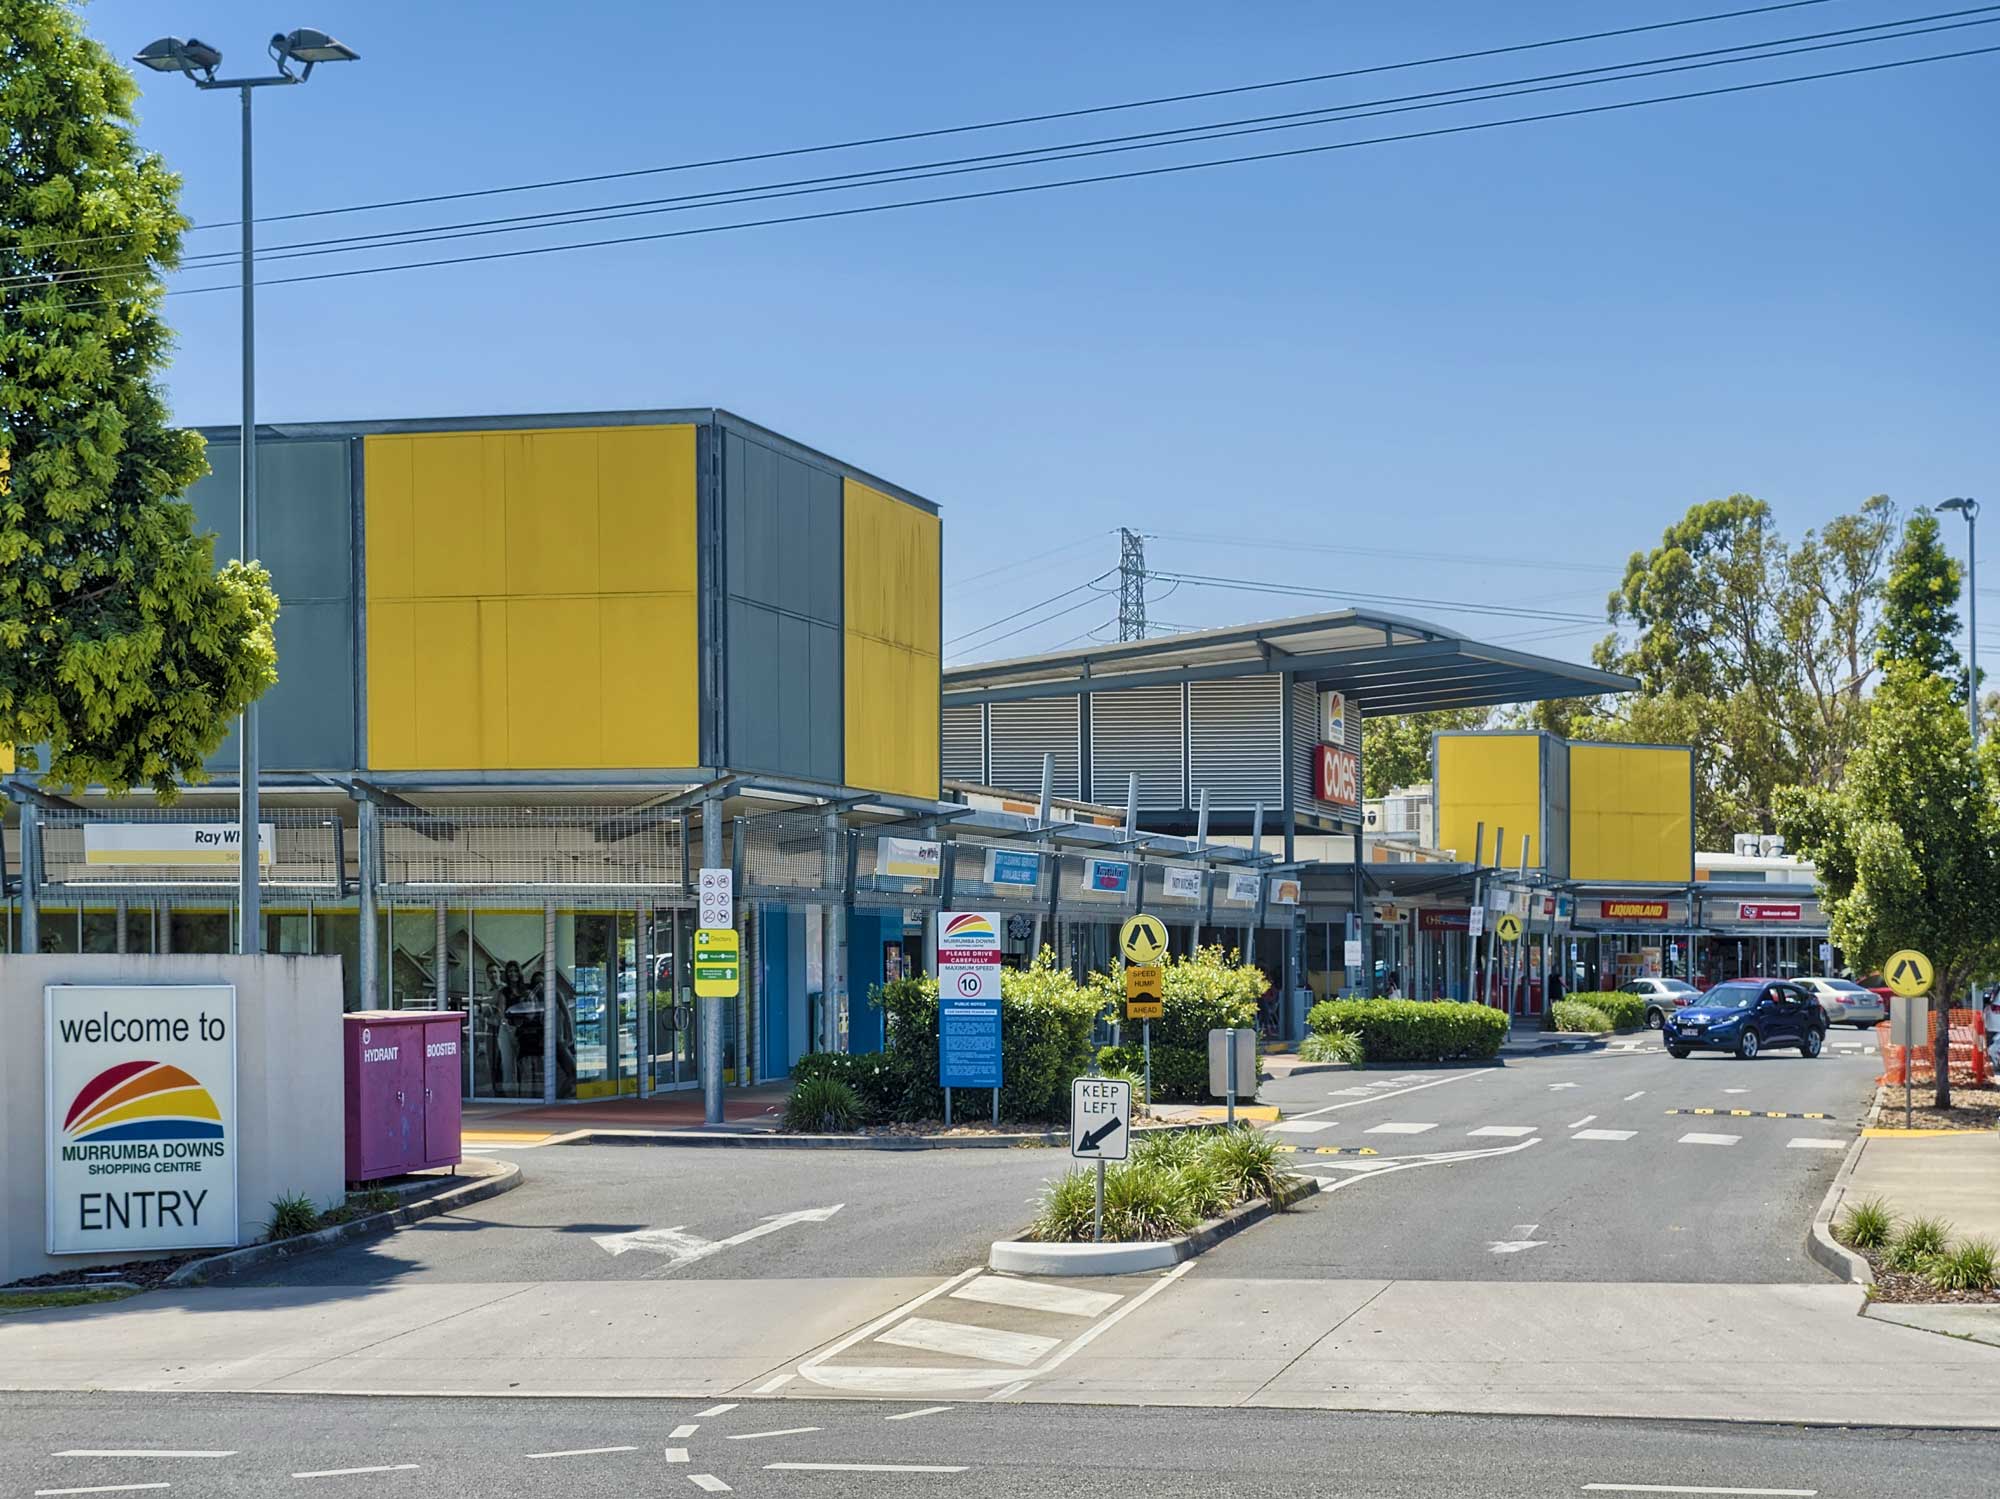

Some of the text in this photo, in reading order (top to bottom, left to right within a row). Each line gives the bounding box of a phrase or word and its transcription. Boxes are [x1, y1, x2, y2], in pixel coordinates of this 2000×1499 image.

[1325, 751, 1355, 801] coles
[195, 831, 221, 845] Ray
[1609, 904, 1663, 916] LIQUORLAND
[961, 978, 978, 991] 10
[1134, 980, 1154, 988] HUMP
[1133, 1006, 1157, 1014] AHEAD
[60, 1011, 225, 1043] welcome to
[364, 1047, 399, 1062] HYDRANT
[427, 1042, 456, 1057] BOOSTER
[1082, 1085, 1119, 1098] KEEP
[1083, 1102, 1117, 1114] LEFT
[62, 1142, 225, 1161] MURRUMBA DOWNS
[88, 1161, 202, 1175] SHOPPING CENTRE
[80, 1189, 208, 1230] ENTRY
